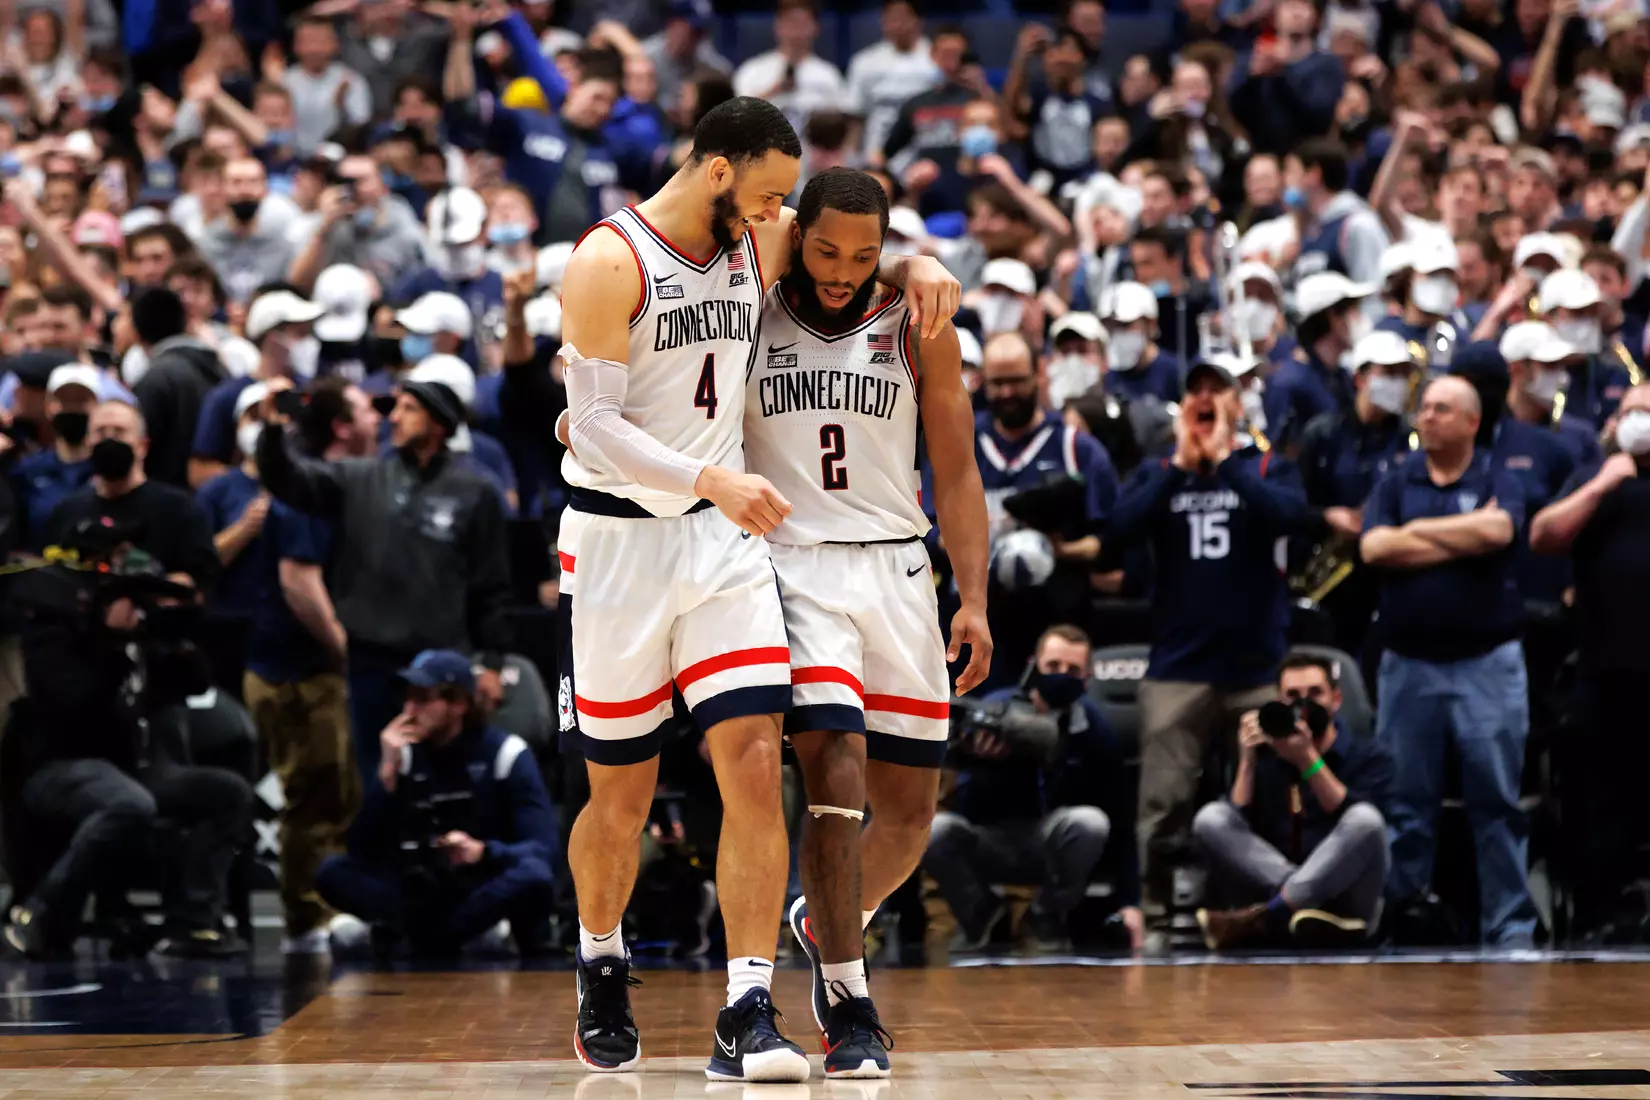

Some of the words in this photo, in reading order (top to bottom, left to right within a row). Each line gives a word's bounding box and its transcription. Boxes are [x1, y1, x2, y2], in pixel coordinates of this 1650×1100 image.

[729, 277, 749, 285] EAST
[654, 300, 752, 352] CONNECTICUT
[694, 352, 718, 420] 4
[760, 370, 900, 420] CONNECTICUT
[819, 424, 848, 490] 2
[1187, 511, 1230, 560] 15
[1094, 659, 1149, 680] UCO
